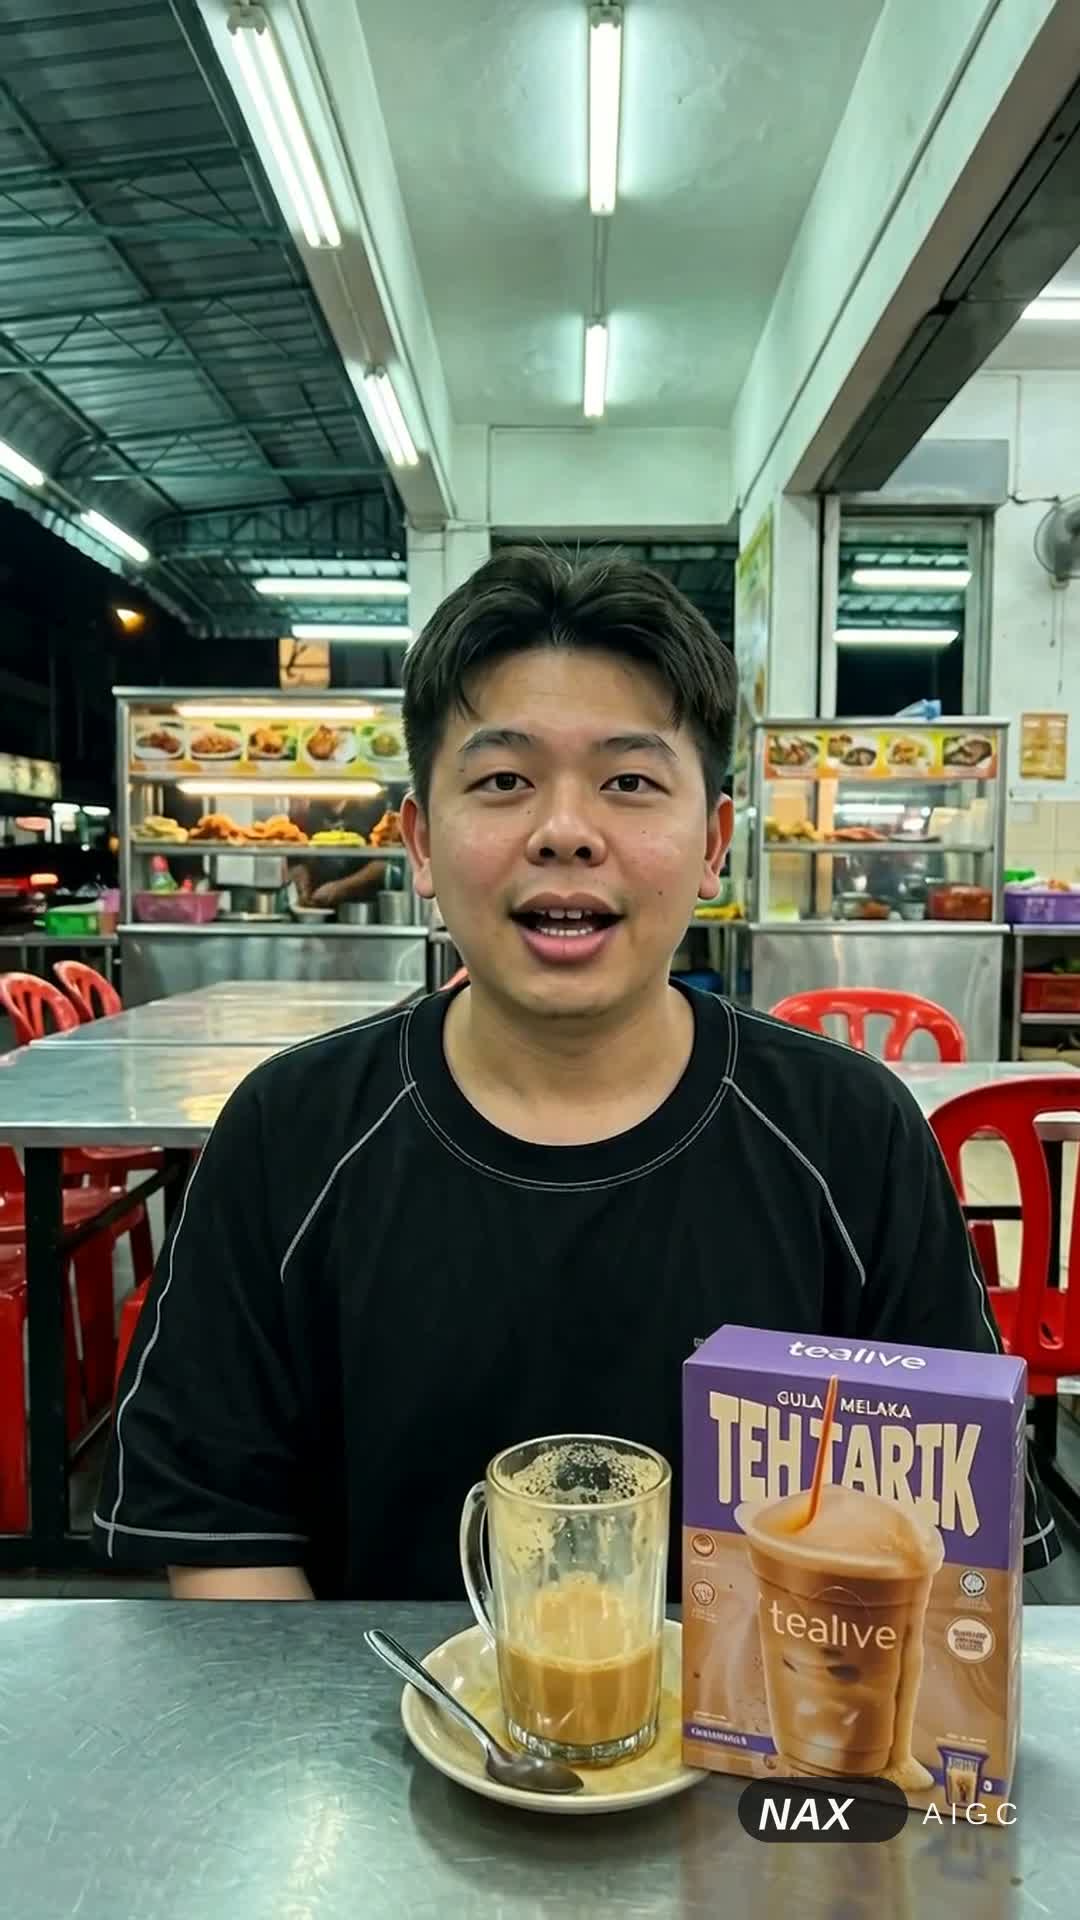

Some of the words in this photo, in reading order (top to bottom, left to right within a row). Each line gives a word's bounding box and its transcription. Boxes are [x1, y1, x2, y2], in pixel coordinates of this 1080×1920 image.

[788, 1341, 927, 1370] tealive
[777, 1391, 824, 1410] GULA
[840, 1398, 912, 1419] MELAKA
[709, 1391, 802, 1504] TEH
[769, 1601, 897, 1649] tealive
